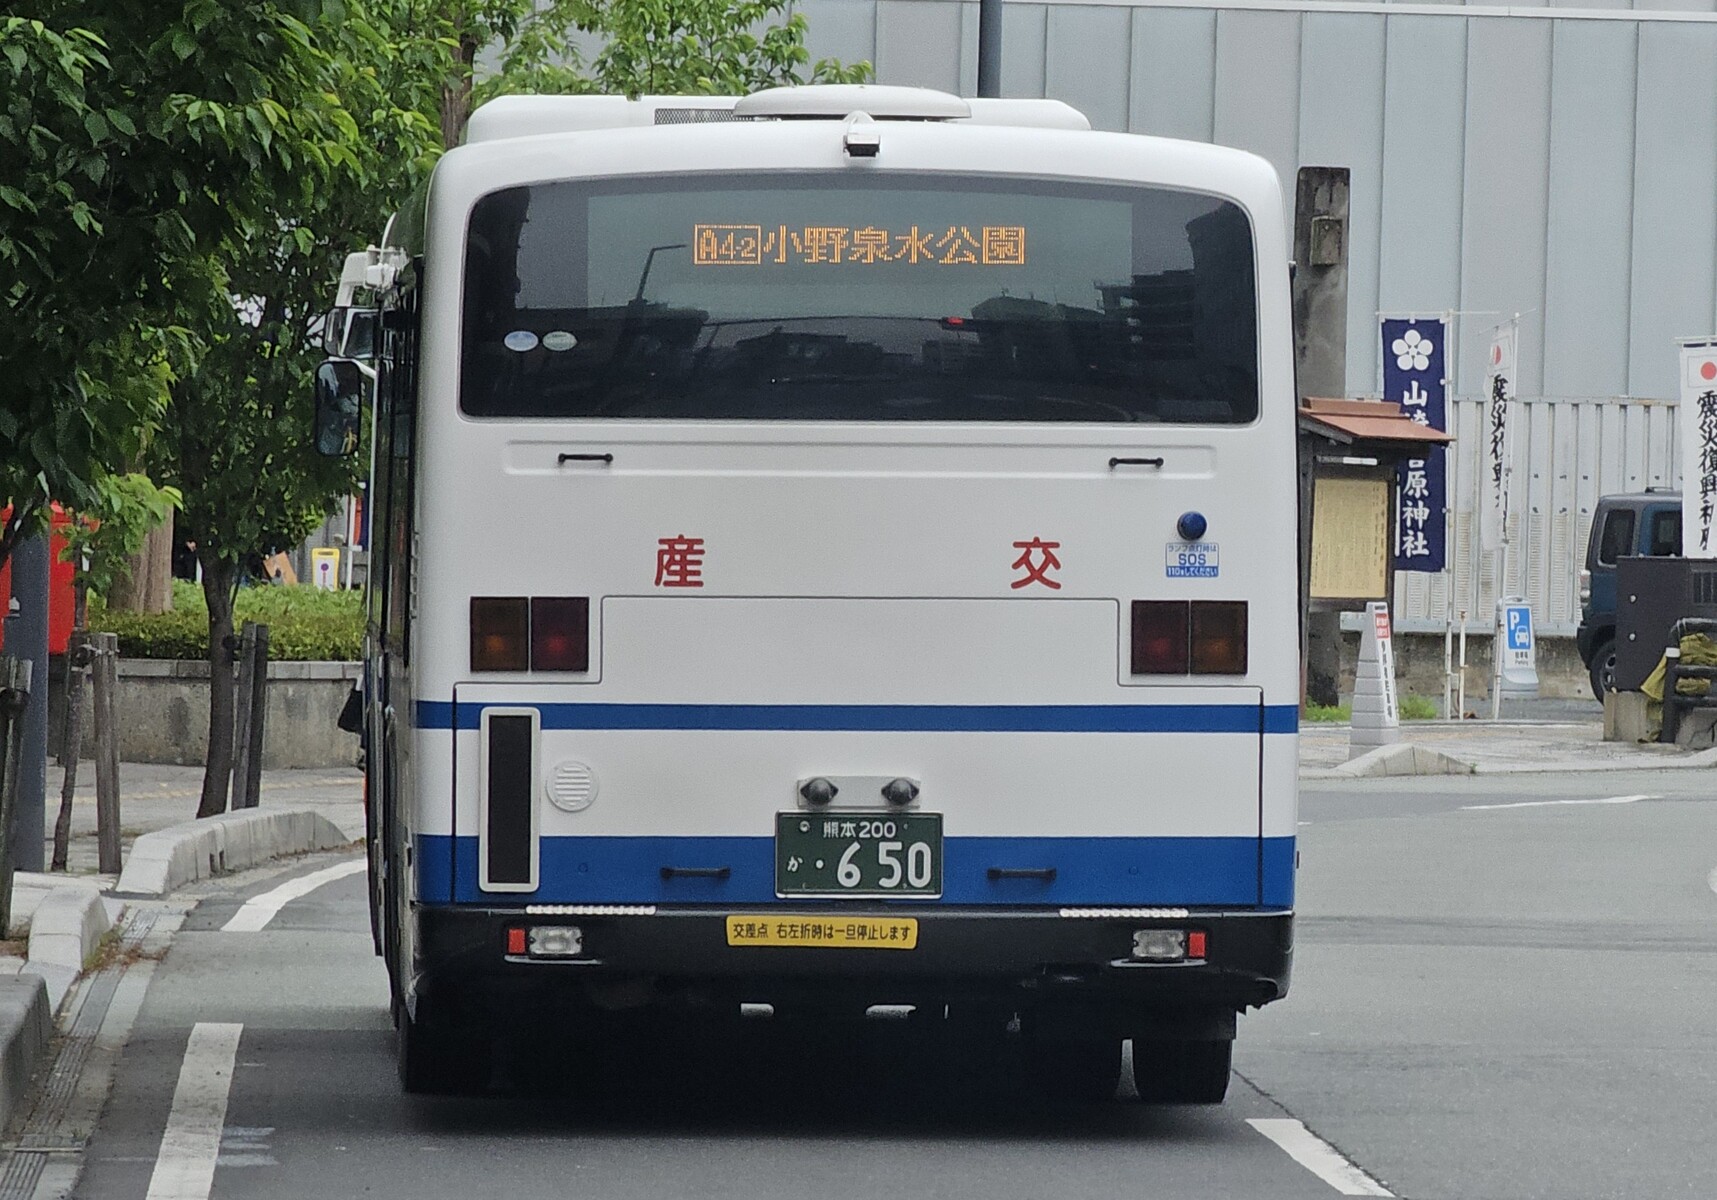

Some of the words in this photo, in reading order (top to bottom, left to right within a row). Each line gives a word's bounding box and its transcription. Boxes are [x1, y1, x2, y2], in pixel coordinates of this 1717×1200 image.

[763, 224, 1026, 265] 小野泉水公園
[654, 533, 706, 588] 産
[1010, 536, 1062, 590] 交
[1178, 553, 1206, 566] SOS
[1509, 611, 1520, 631] P
[733, 922, 769, 939] 交差点
[776, 923, 911, 941] 右左折時は一旦停止します
